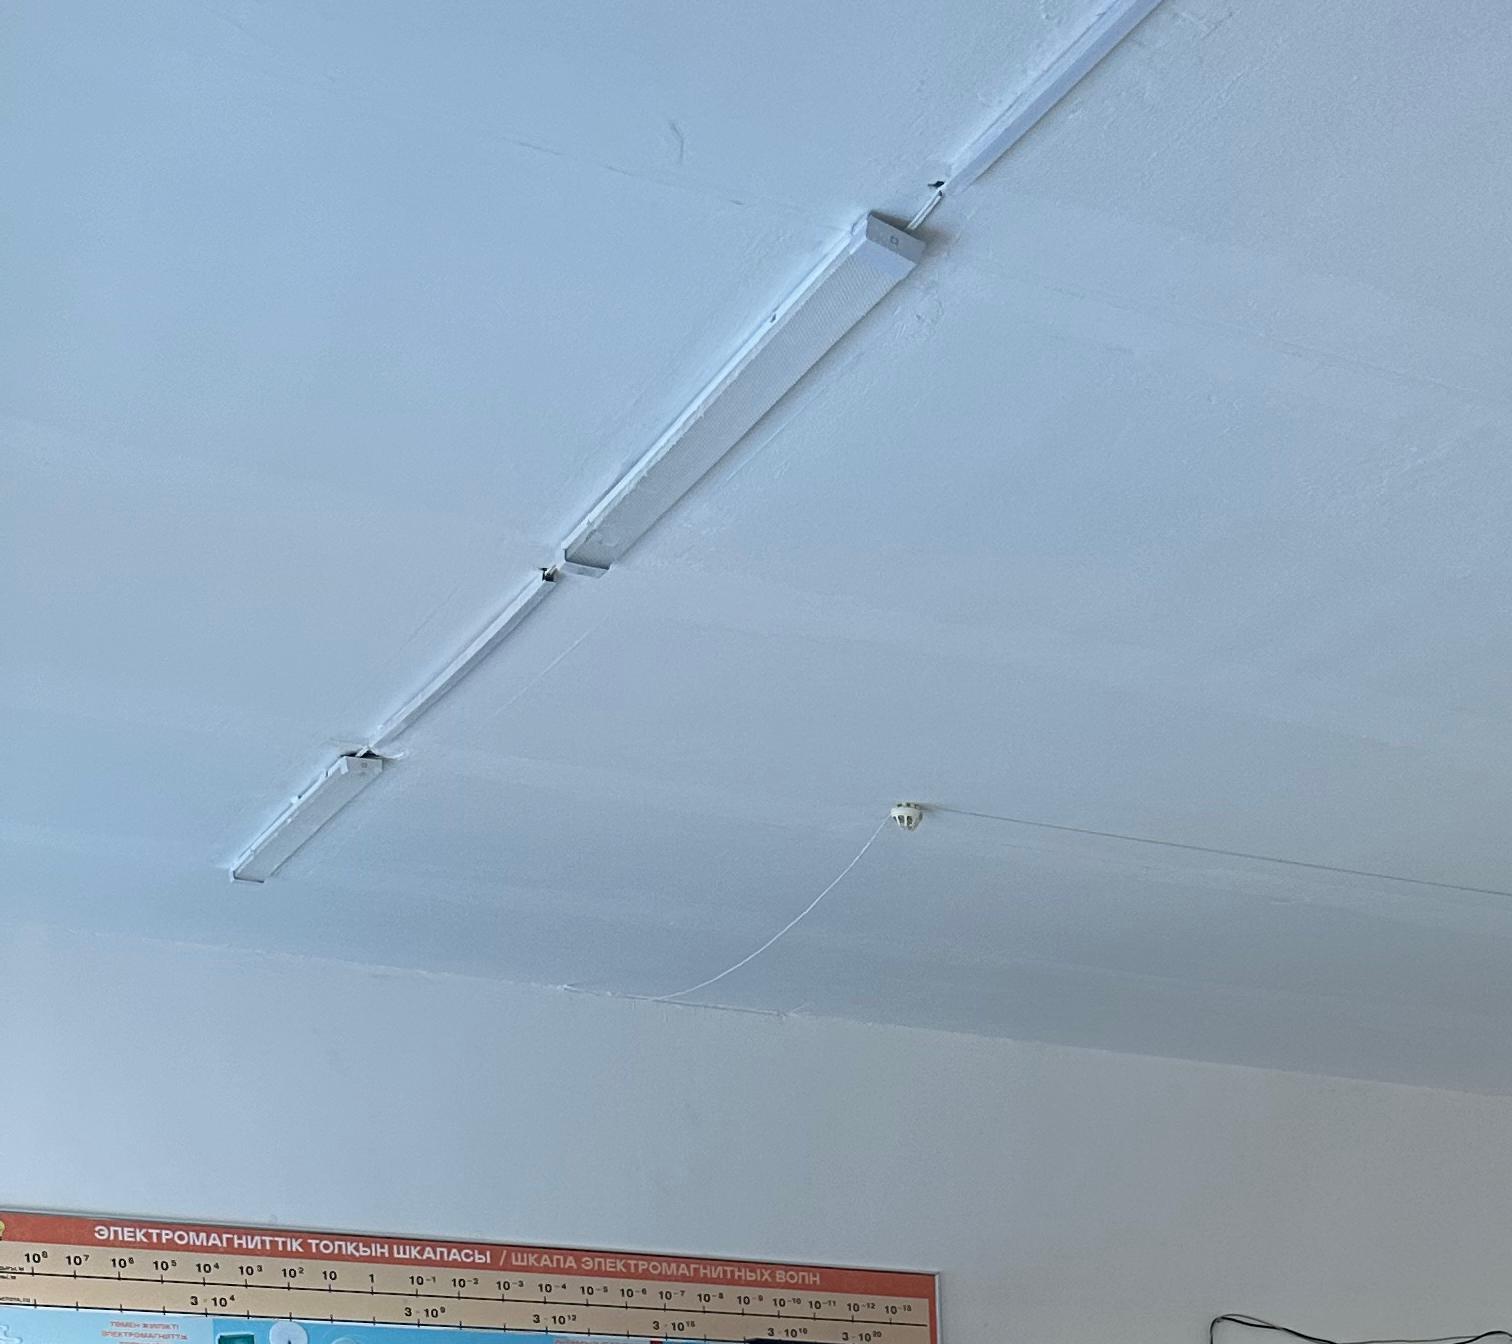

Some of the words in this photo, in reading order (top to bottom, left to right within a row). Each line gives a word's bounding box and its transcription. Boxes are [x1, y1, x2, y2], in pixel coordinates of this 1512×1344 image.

[94, 1225, 304, 1252] ЭЛЕКТРОМАГНИТТІК
[308, 1238, 389, 1258] ТОЛҚЫН
[394, 1244, 491, 1264] ШКАЛАСЫ
[511, 1253, 577, 1270] ШКАЛА
[581, 1257, 772, 1282] ЭЛЕКТРОМАГНИТНЫХ
[776, 1271, 820, 1286] ВОЛН
[322, 1270, 337, 1281] 10
[368, 1273, 375, 1284] 1
